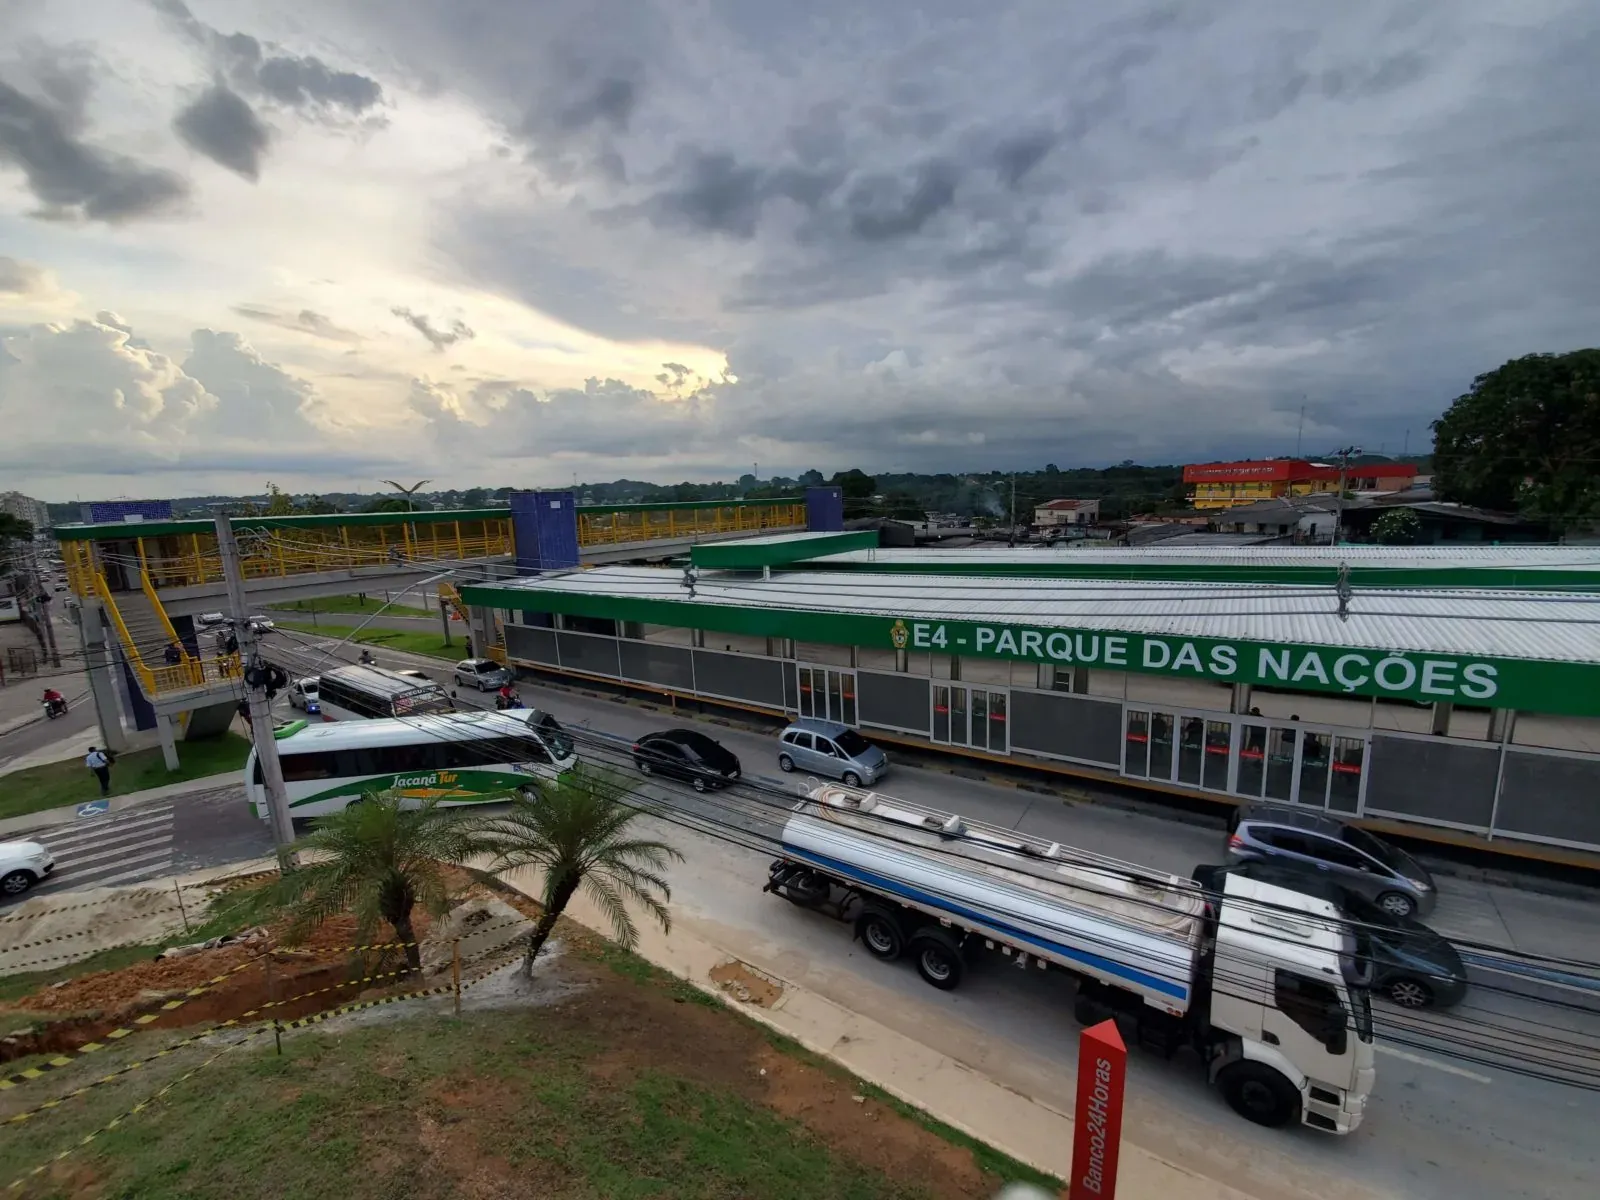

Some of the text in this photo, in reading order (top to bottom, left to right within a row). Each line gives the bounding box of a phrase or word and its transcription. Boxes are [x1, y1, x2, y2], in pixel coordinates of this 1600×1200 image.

[913, 623, 948, 649] E4
[976, 627, 1128, 665] PARQUE
[1142, 639, 1238, 676] DAS
[1257, 648, 1498, 699] NAÇÕES
[390, 770, 458, 789] Jaçanã Tur
[1083, 1058, 1112, 1194] Banco24Horas
